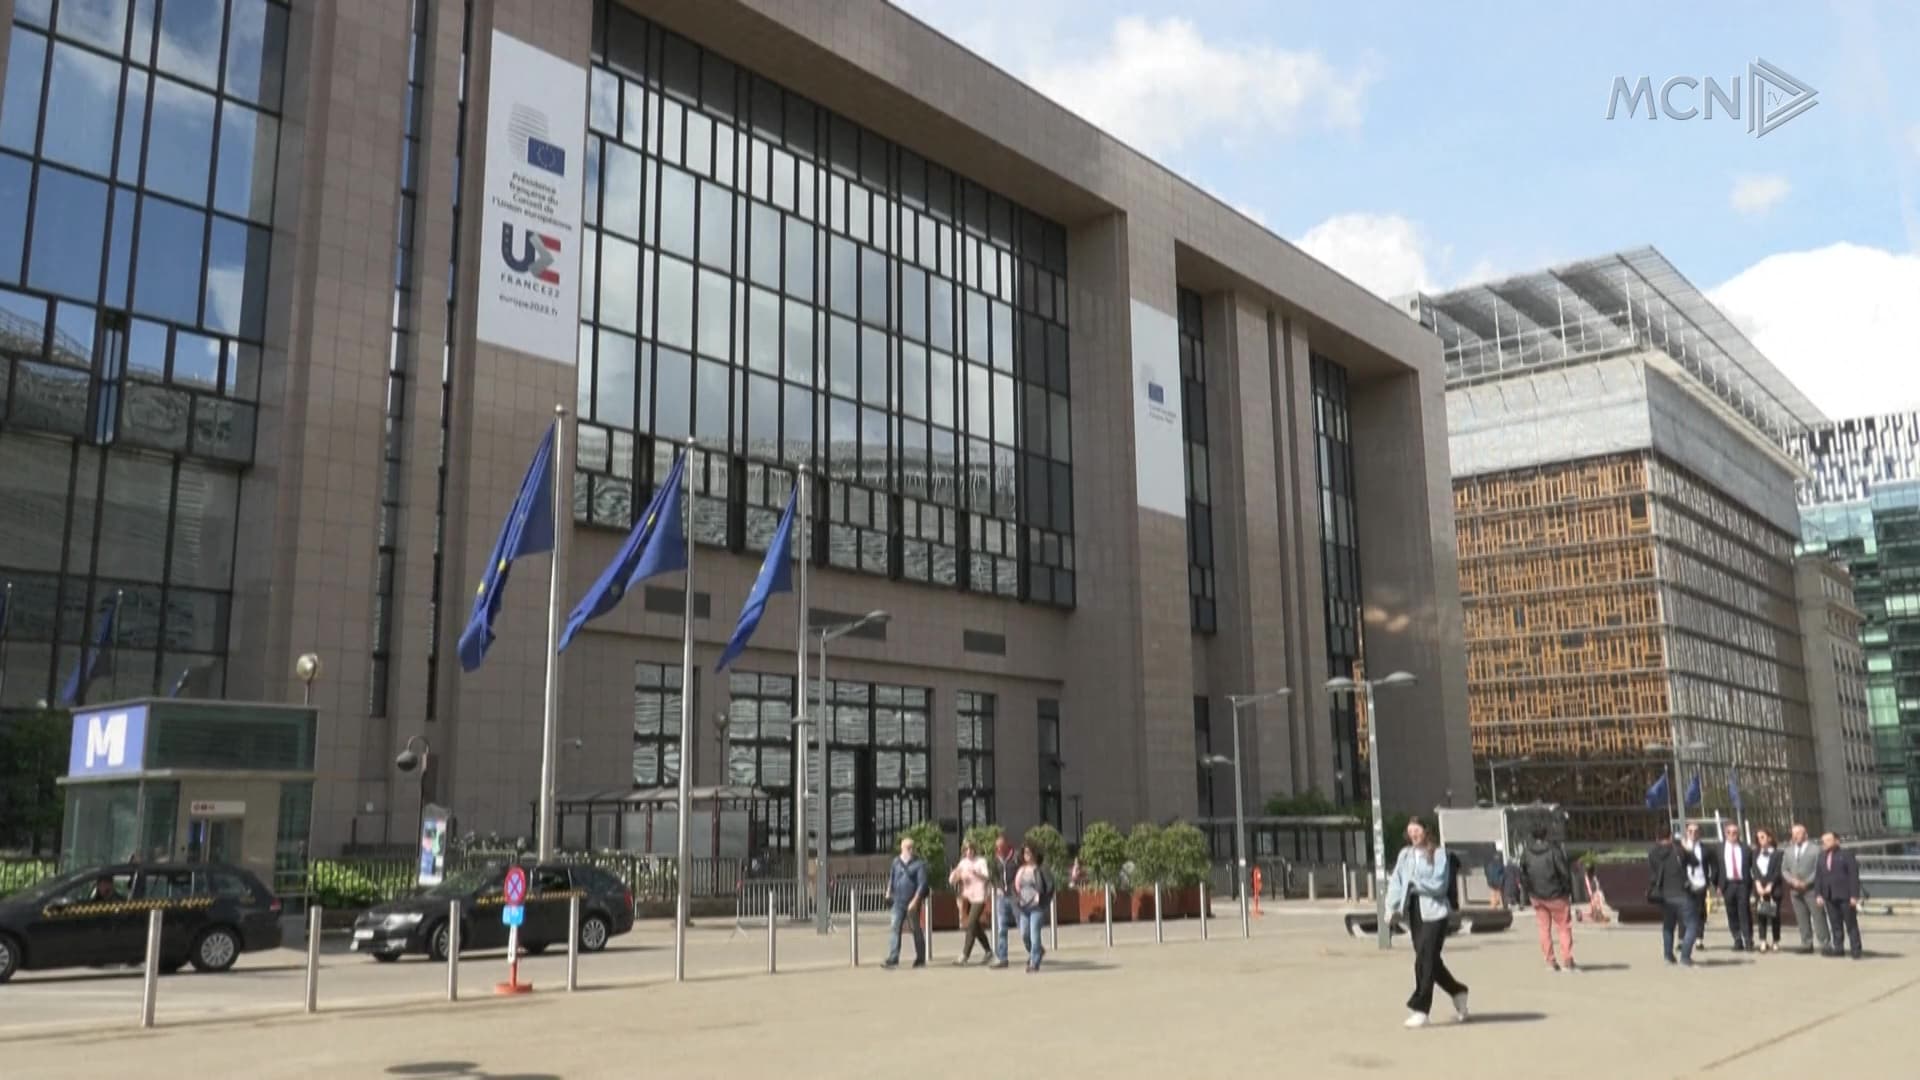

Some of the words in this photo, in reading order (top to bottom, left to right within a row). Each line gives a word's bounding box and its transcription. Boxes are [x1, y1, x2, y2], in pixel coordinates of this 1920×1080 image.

[512, 171, 557, 194] Présidence
[512, 193, 543, 211] Conseil
[543, 205, 555, 215] de
[547, 195, 559, 206] du
[85, 713, 128, 769] M
